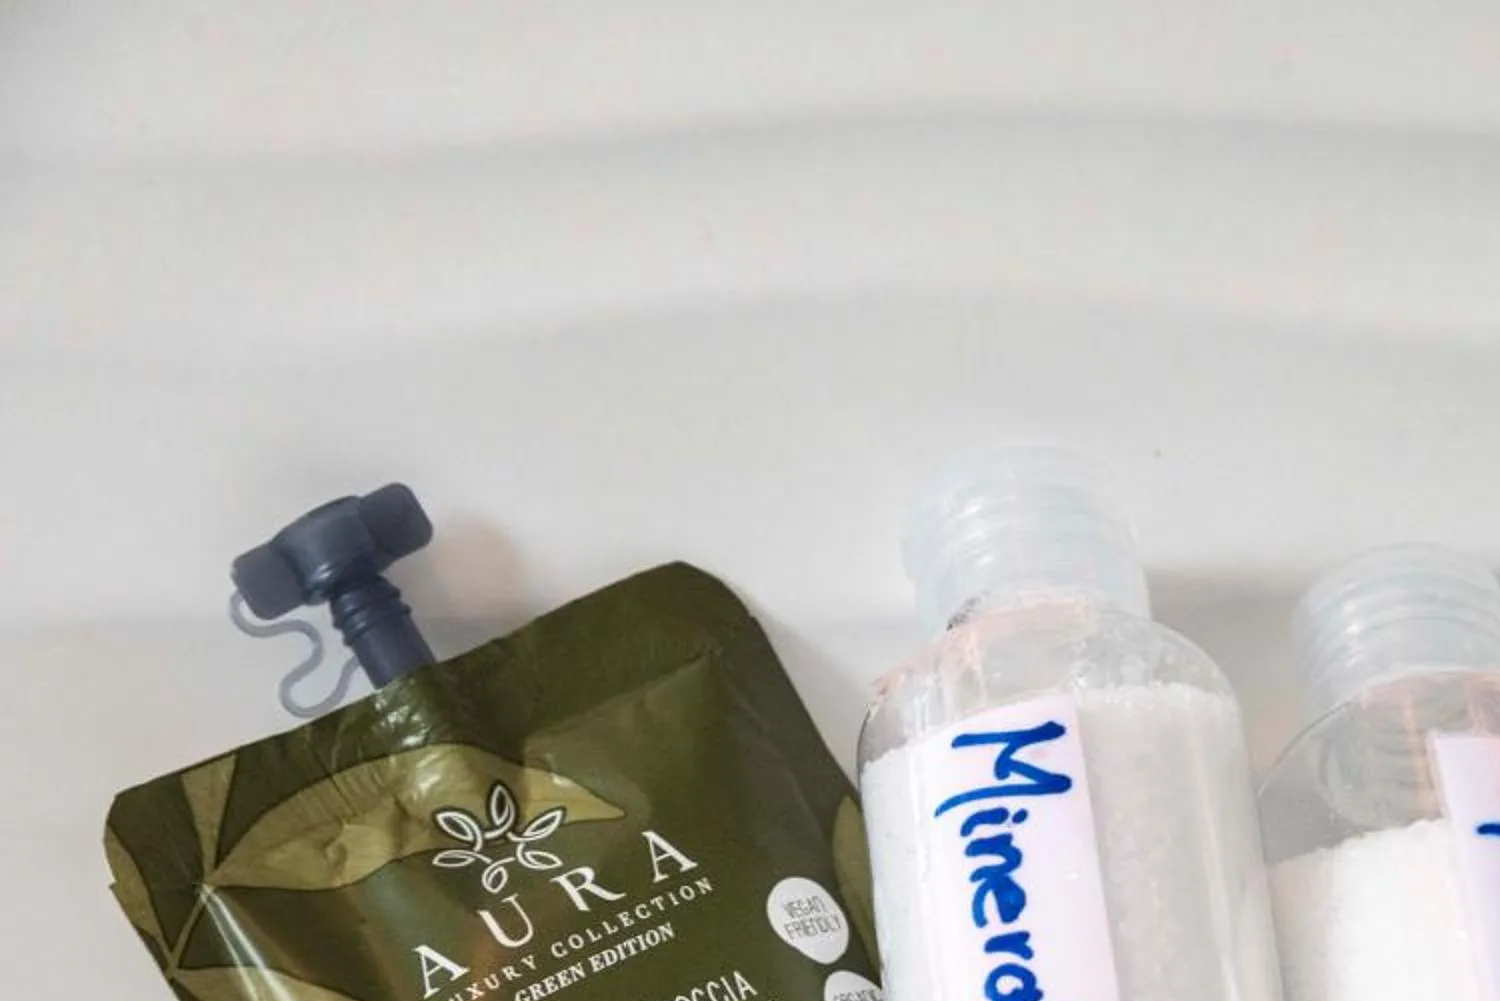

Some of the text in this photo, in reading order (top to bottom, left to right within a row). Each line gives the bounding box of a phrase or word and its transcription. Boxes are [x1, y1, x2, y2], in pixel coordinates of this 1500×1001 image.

[413, 830, 698, 999] AURA
[551, 876, 714, 960] COLLECTION
[591, 923, 675, 974] EDITION
